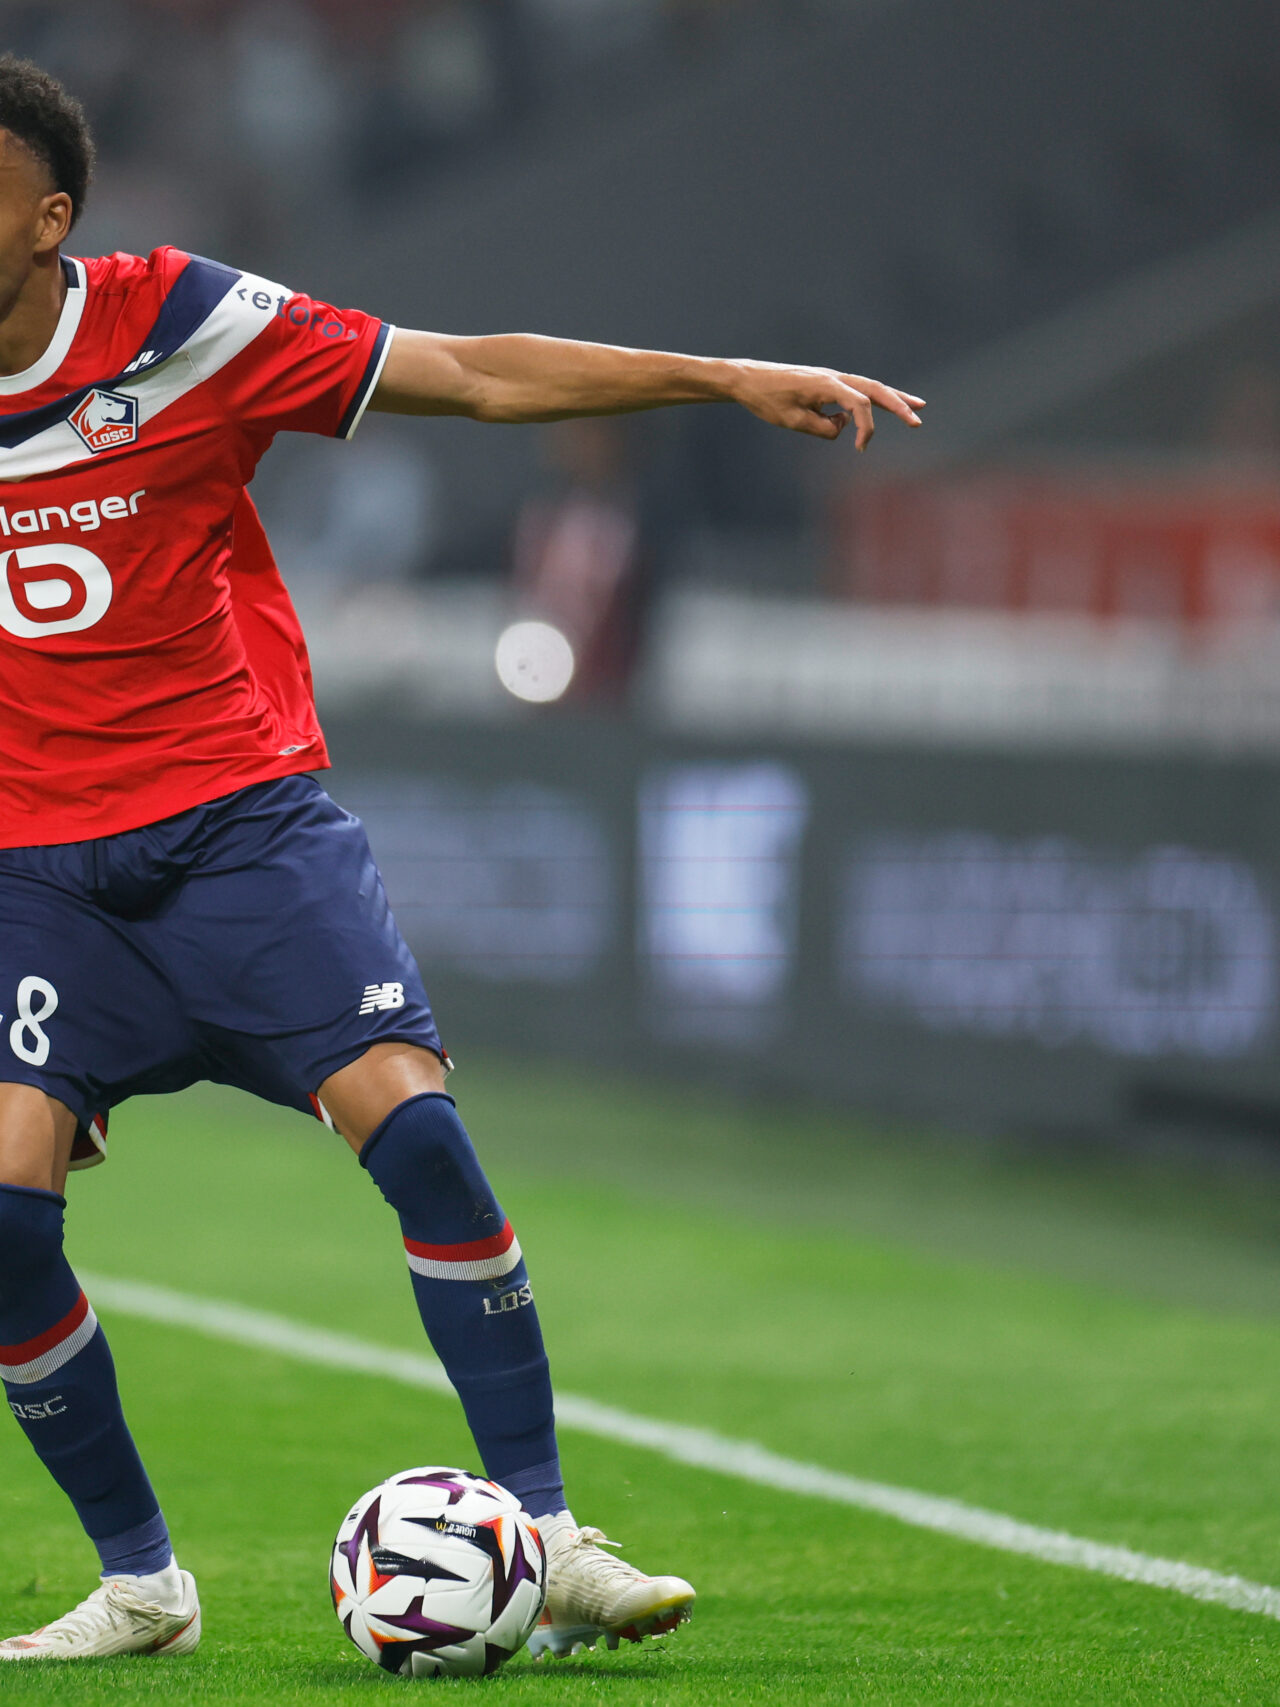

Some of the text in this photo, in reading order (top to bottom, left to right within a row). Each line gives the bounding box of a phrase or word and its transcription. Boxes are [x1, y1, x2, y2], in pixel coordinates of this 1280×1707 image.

[92, 428, 130, 446] LOSC
[358, 982, 405, 1015] NB
[9, 975, 59, 1067] 8
[483, 1280, 533, 1315] LOS
[9, 1395, 67, 1419] OSC
